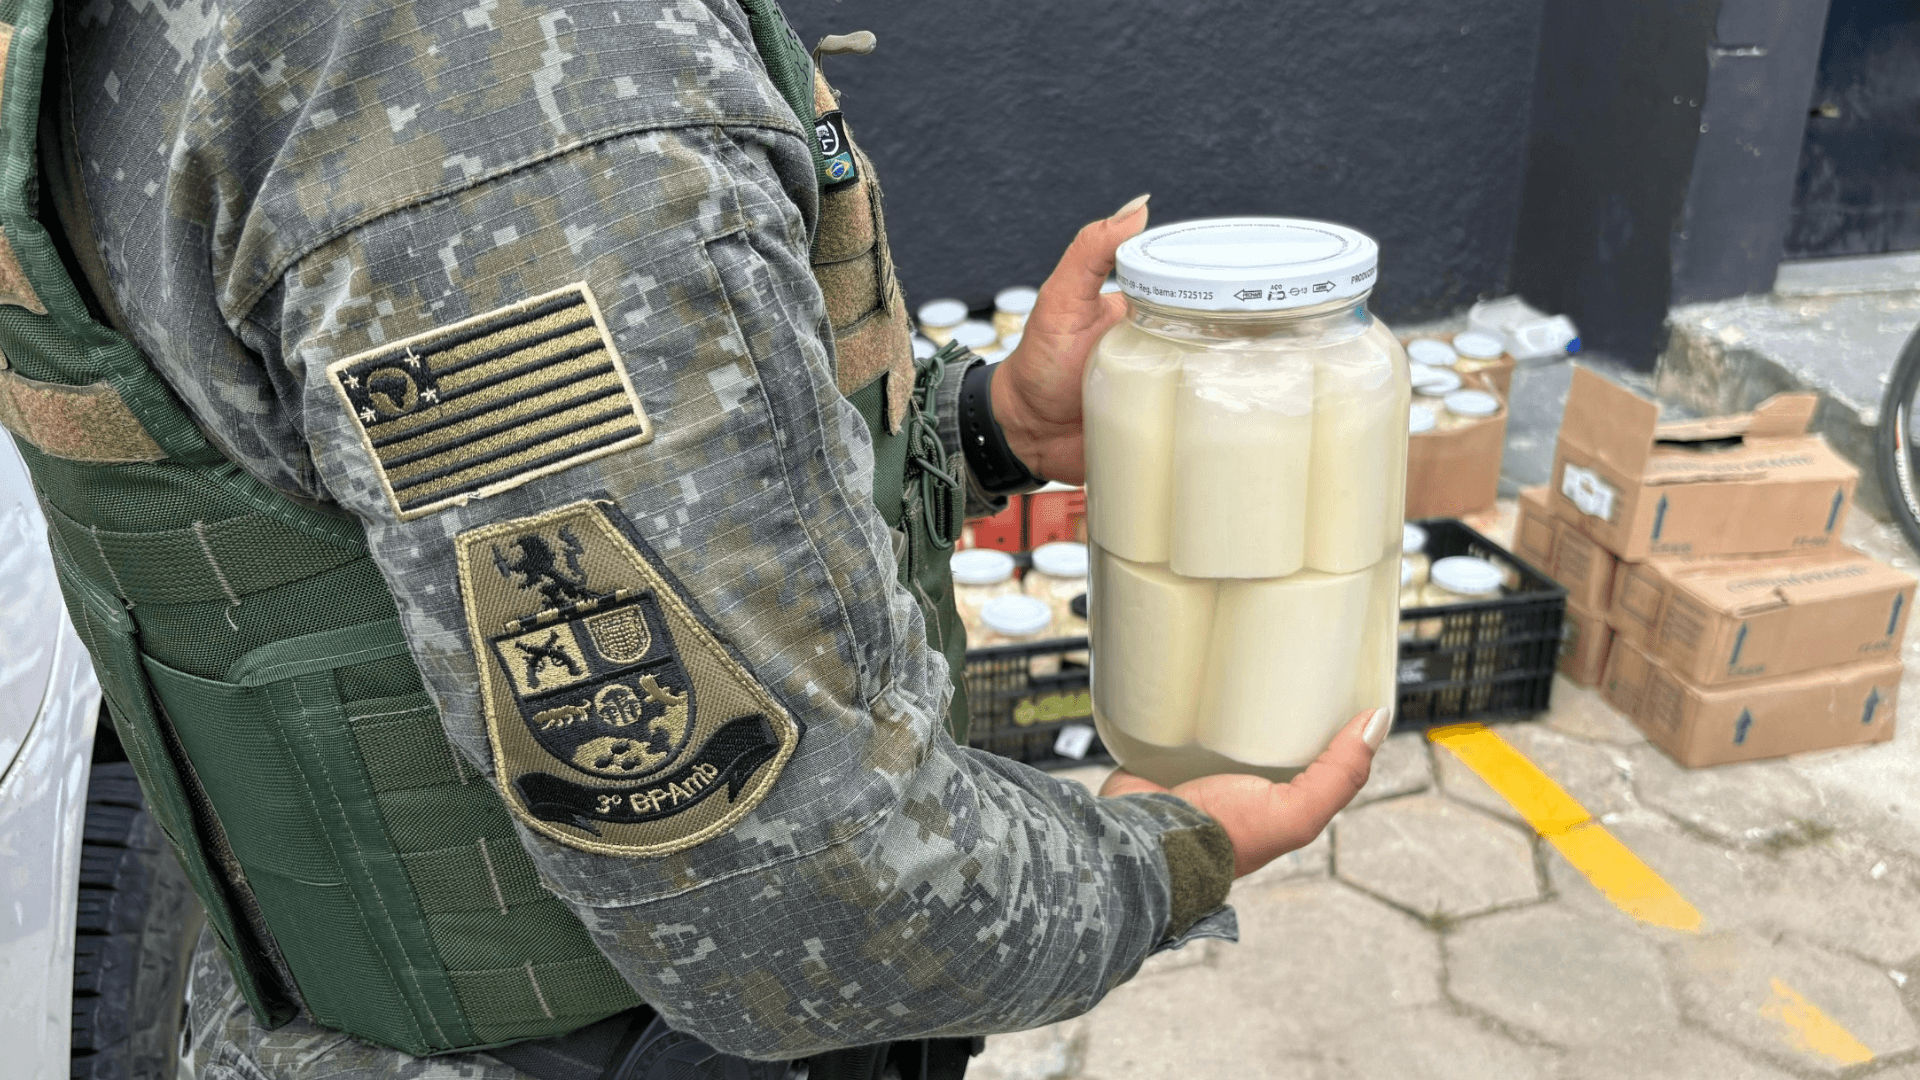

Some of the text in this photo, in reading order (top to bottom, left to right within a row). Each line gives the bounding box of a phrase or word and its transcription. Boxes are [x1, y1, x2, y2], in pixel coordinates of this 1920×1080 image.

[1139, 283, 1152, 295] Reg.
[1153, 286, 1177, 298] Ibama:
[1178, 289, 1214, 300] 7525125
[629, 763, 718, 814] BPAmb
